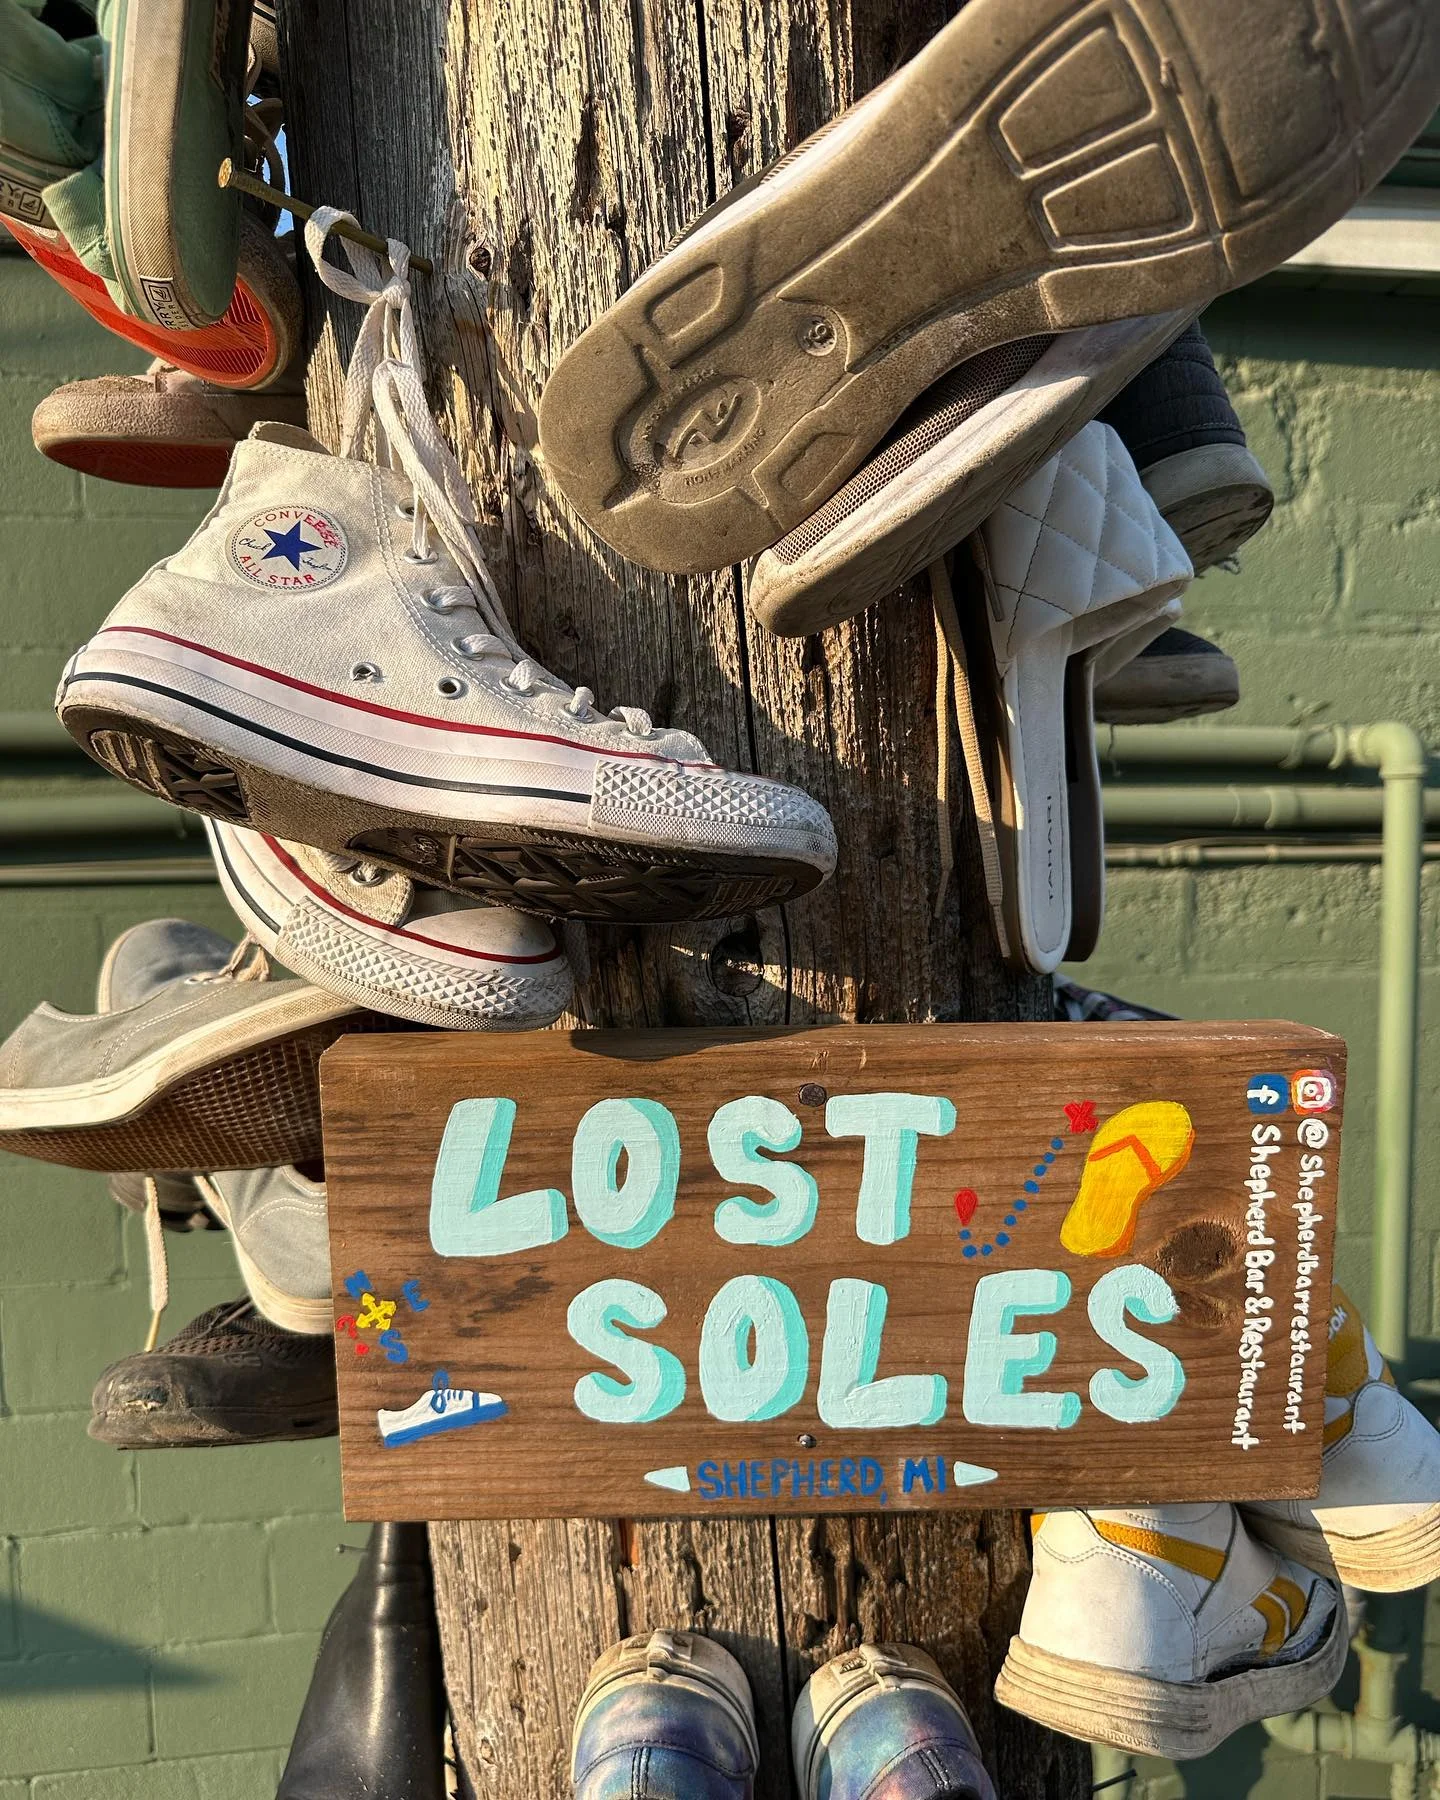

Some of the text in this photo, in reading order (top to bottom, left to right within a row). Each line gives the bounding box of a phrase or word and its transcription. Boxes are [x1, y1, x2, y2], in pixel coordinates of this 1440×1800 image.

[239, 554, 316, 586] ALL STAR
[429, 1091, 957, 1258] LOST
[402, 1279, 430, 1312] E
[1231, 1122, 1281, 1451] Shepherd Bar & Restaurant
[379, 1328, 409, 1364] S
[566, 1263, 1186, 1430] SOLES
[697, 1455, 947, 1505] SHEPHERD, MI
